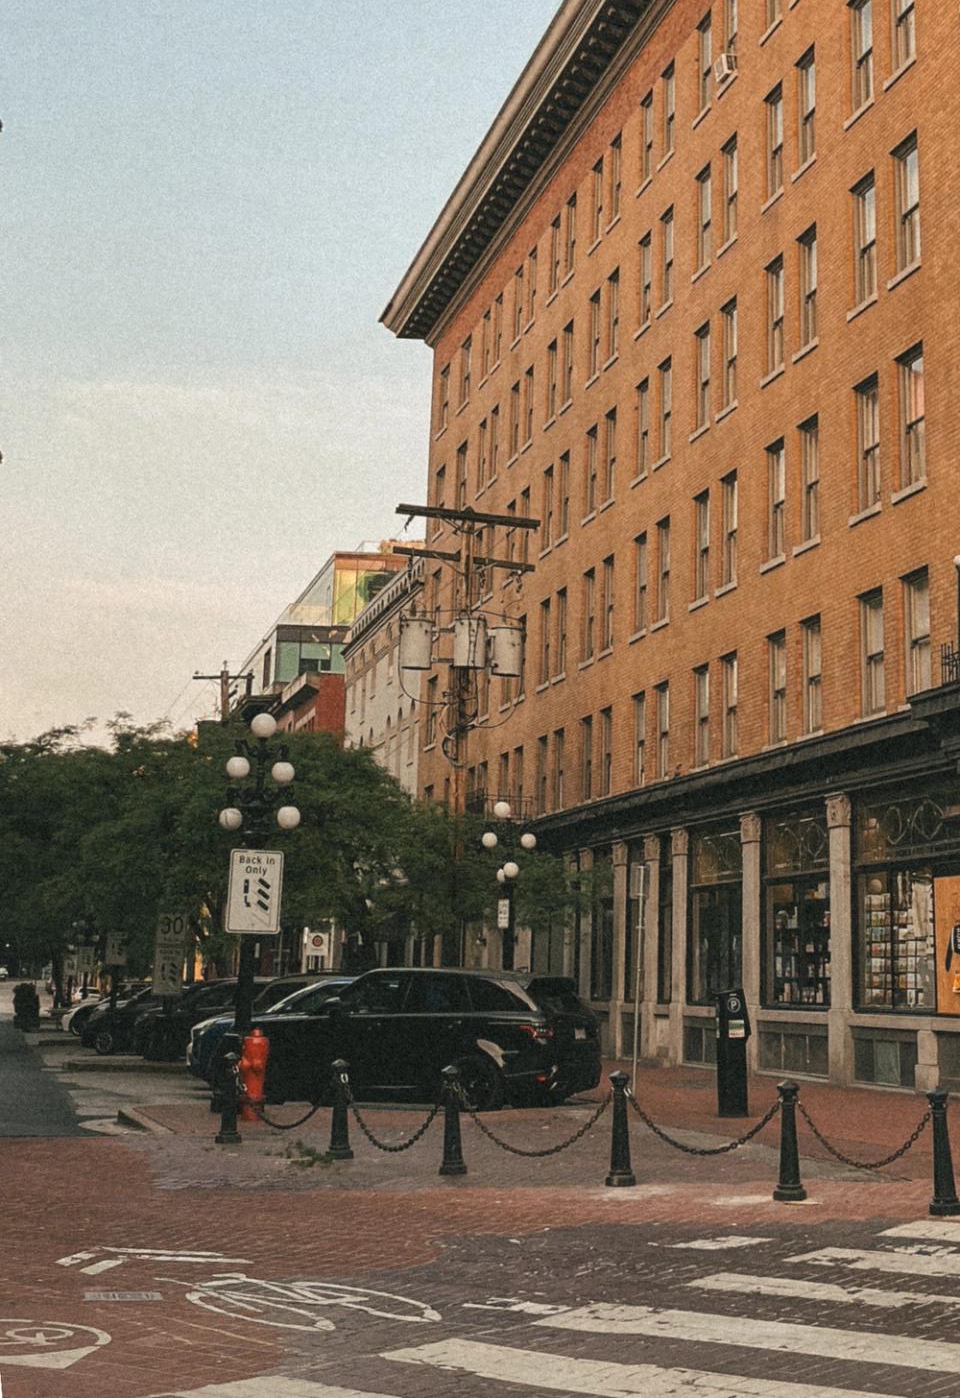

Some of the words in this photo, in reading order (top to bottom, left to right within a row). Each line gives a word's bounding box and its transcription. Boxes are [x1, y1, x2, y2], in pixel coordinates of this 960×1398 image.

[239, 855, 262, 865] Back
[245, 865, 268, 877] Only
[161, 916, 184, 935] 30
